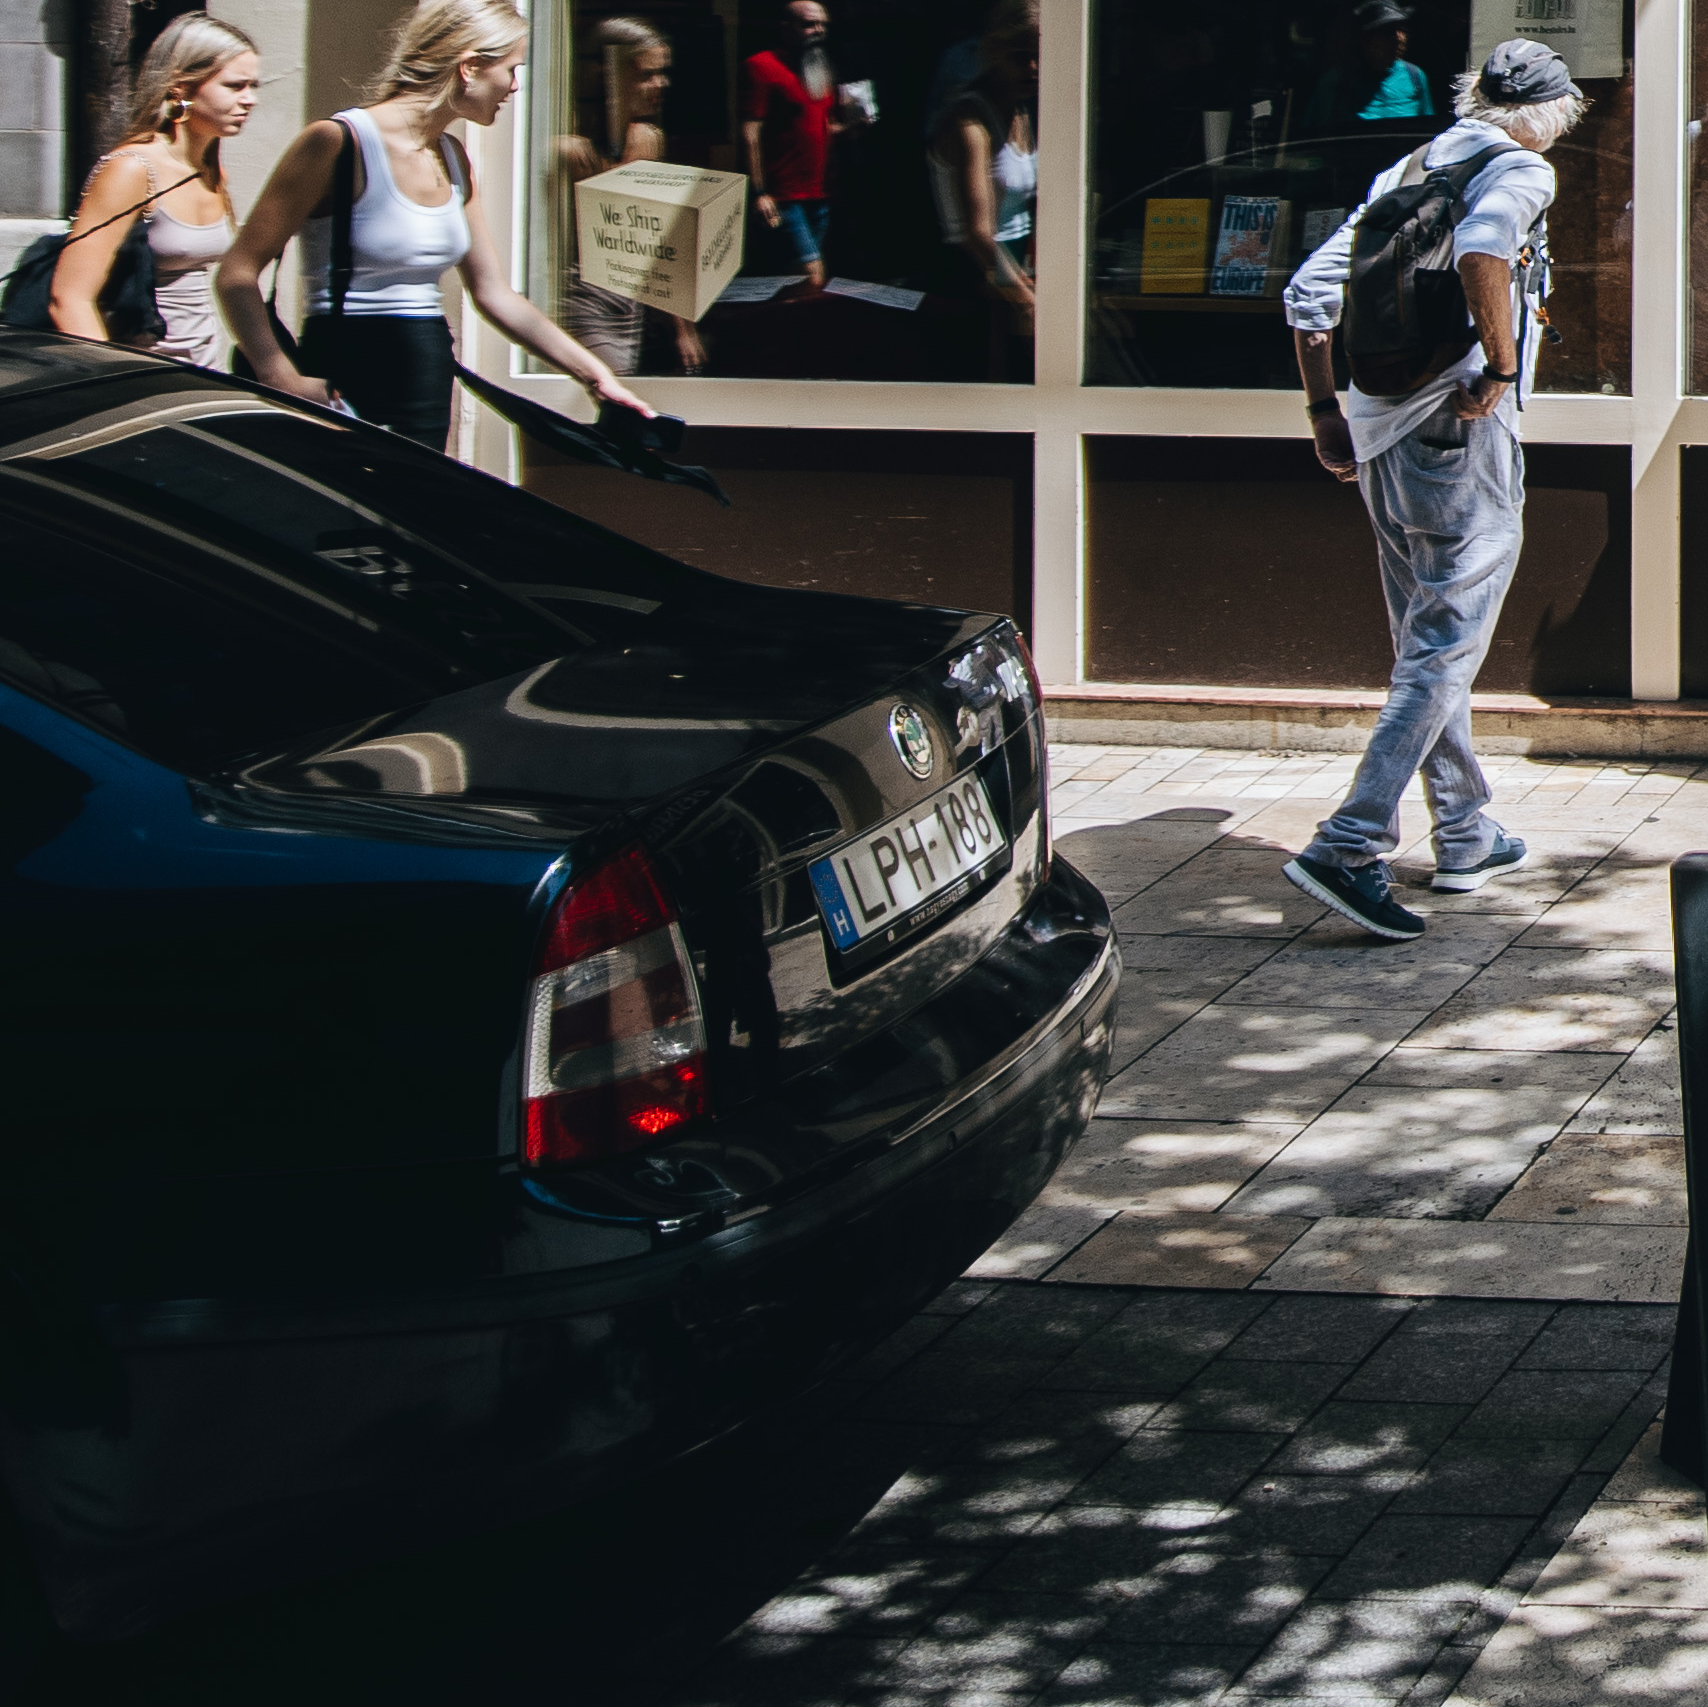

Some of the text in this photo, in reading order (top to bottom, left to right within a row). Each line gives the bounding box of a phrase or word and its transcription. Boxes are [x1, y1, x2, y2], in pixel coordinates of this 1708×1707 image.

[599, 201, 664, 236] We Ship
[592, 226, 678, 262] Worldwide
[843, 781, 993, 925] LPH-188
[832, 908, 852, 936] H
